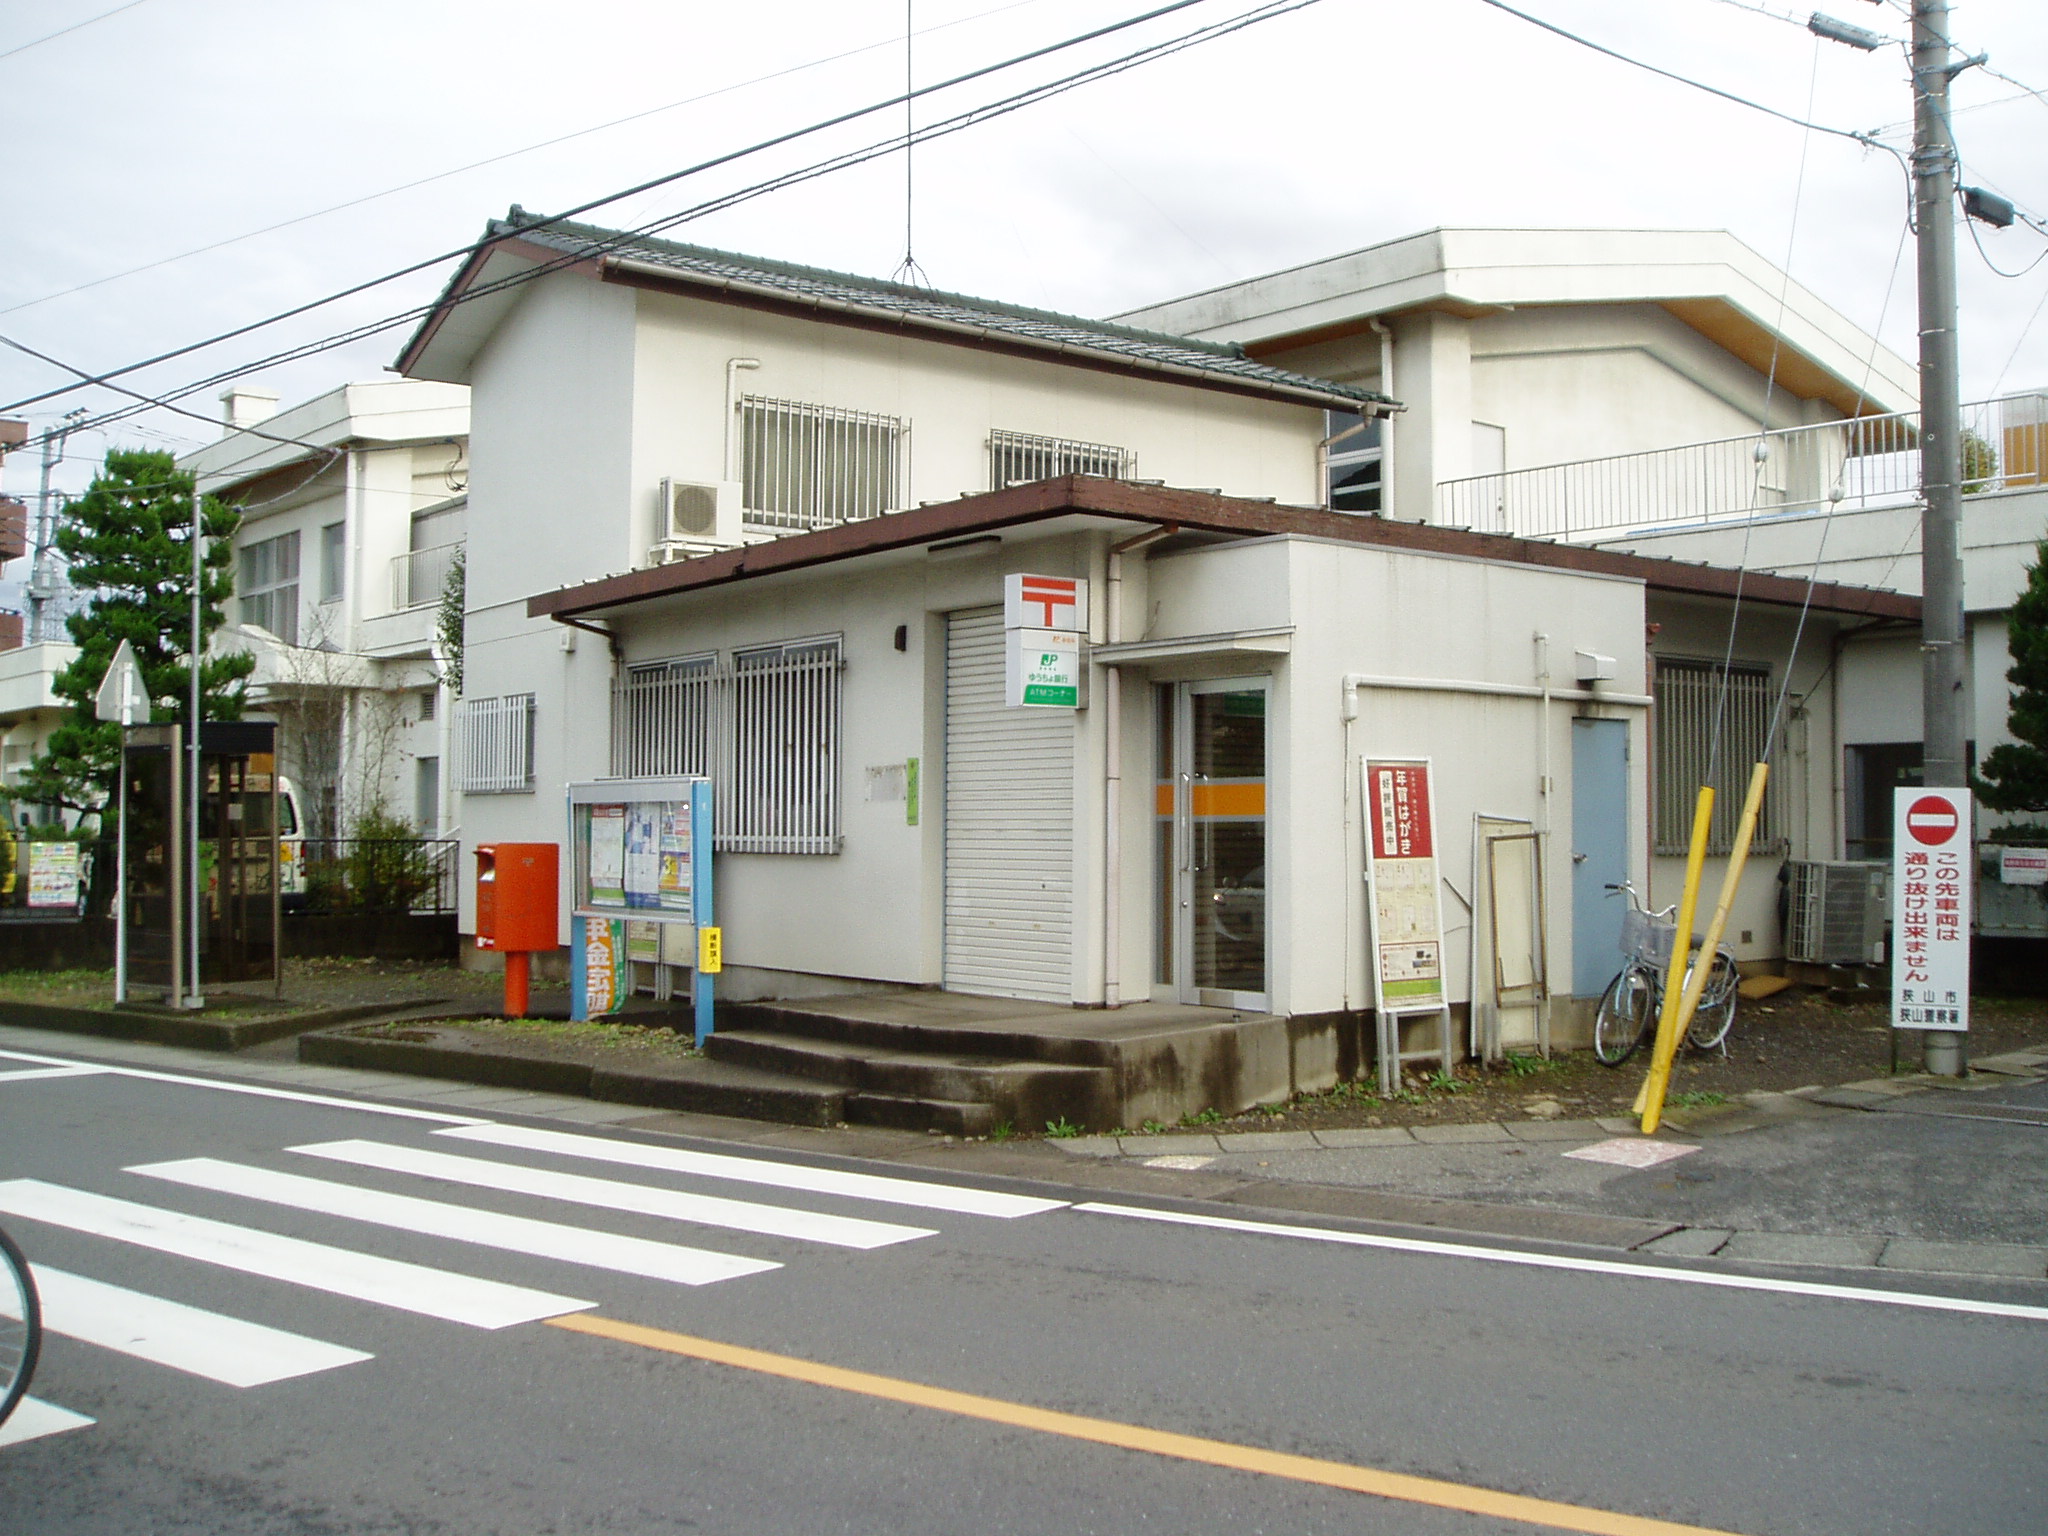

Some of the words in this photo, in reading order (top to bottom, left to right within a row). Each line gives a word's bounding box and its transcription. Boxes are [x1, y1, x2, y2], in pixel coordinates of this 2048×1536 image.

[1040, 653, 1058, 666] JP
[1028, 672, 1069, 684] ゆうちょ銀行
[1029, 688, 1073, 697] ATMコーナー
[1382, 779, 1394, 846] 好評販売中
[1396, 769, 1413, 855] 年賀はがき
[1935, 851, 1960, 941] この先車両は
[1903, 851, 1930, 983] 通り抜け出来ません
[1902, 989, 1957, 1003] 狭山市
[1900, 1008, 1960, 1024] 狭山警察署
